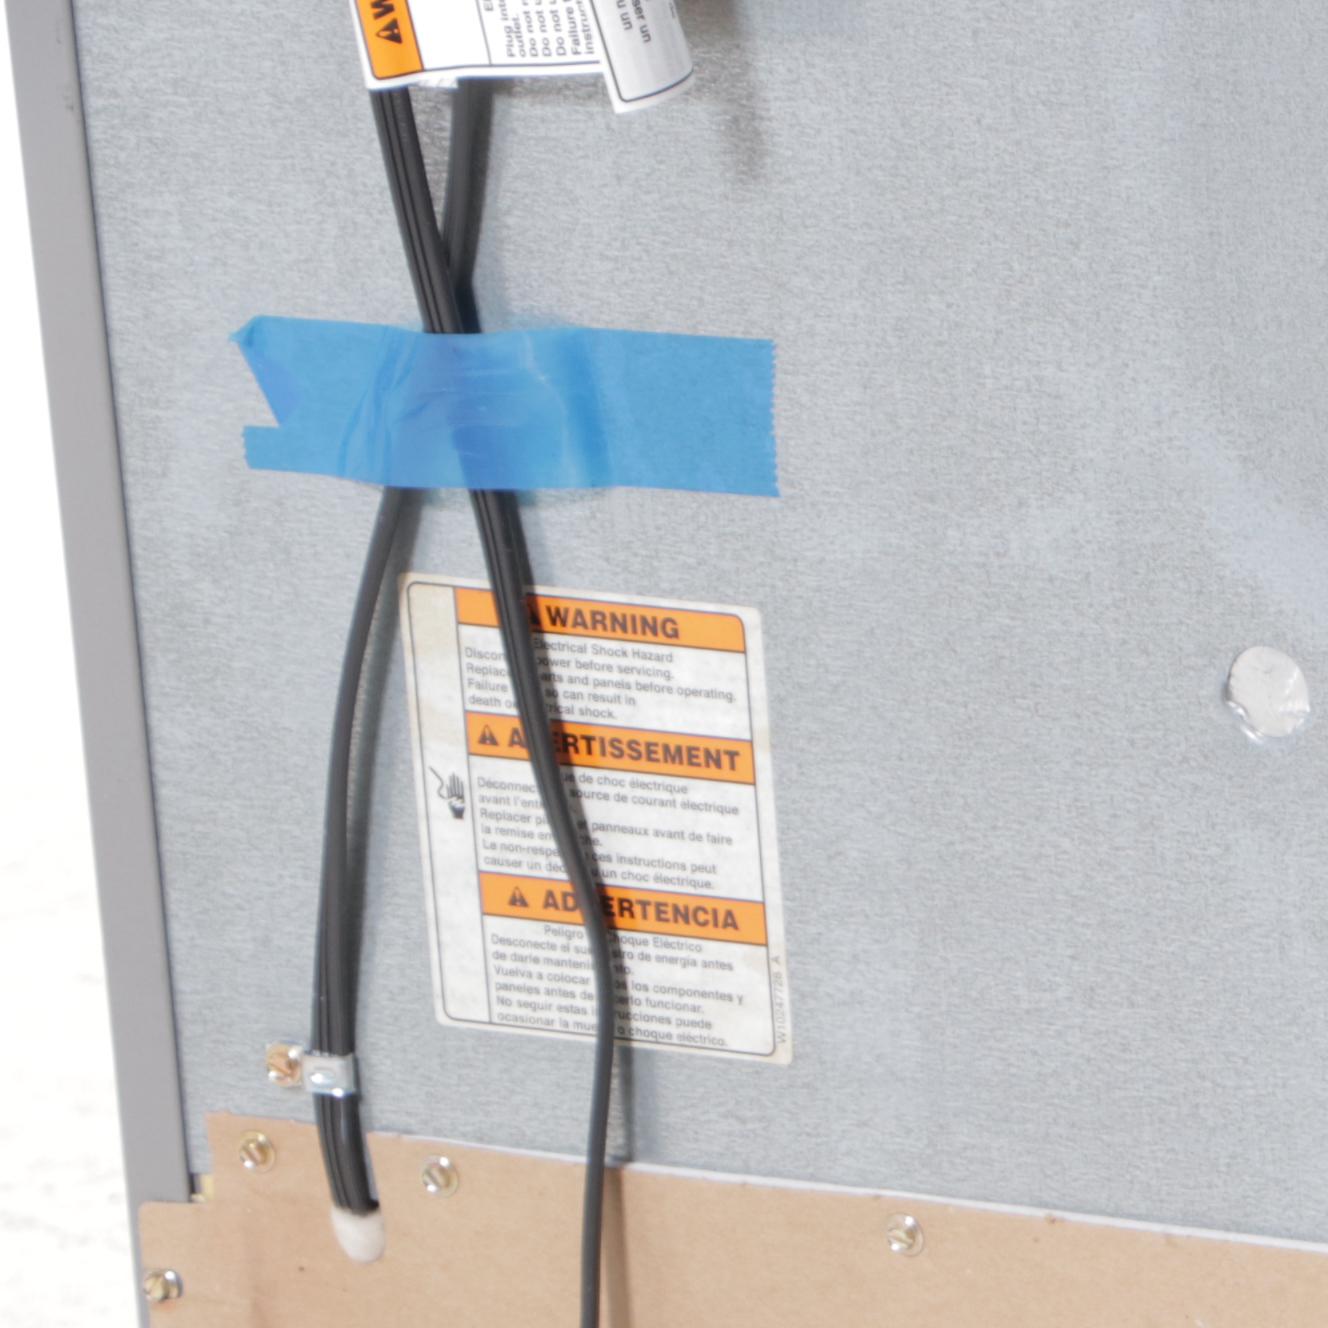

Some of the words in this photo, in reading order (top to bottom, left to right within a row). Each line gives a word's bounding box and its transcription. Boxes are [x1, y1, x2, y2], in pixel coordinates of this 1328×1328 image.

[523, 10, 533, 33] not
[535, 10, 547, 33] not
[549, 9, 562, 32] not
[566, 6, 581, 55] Failure
[504, 25, 515, 57] Plug
[529, 38, 538, 57] Do
[542, 37, 551, 57] Do
[556, 36, 566, 56] Do
[545, 605, 680, 639] WARNING
[543, 889, 739, 931] ADERTENCIA
